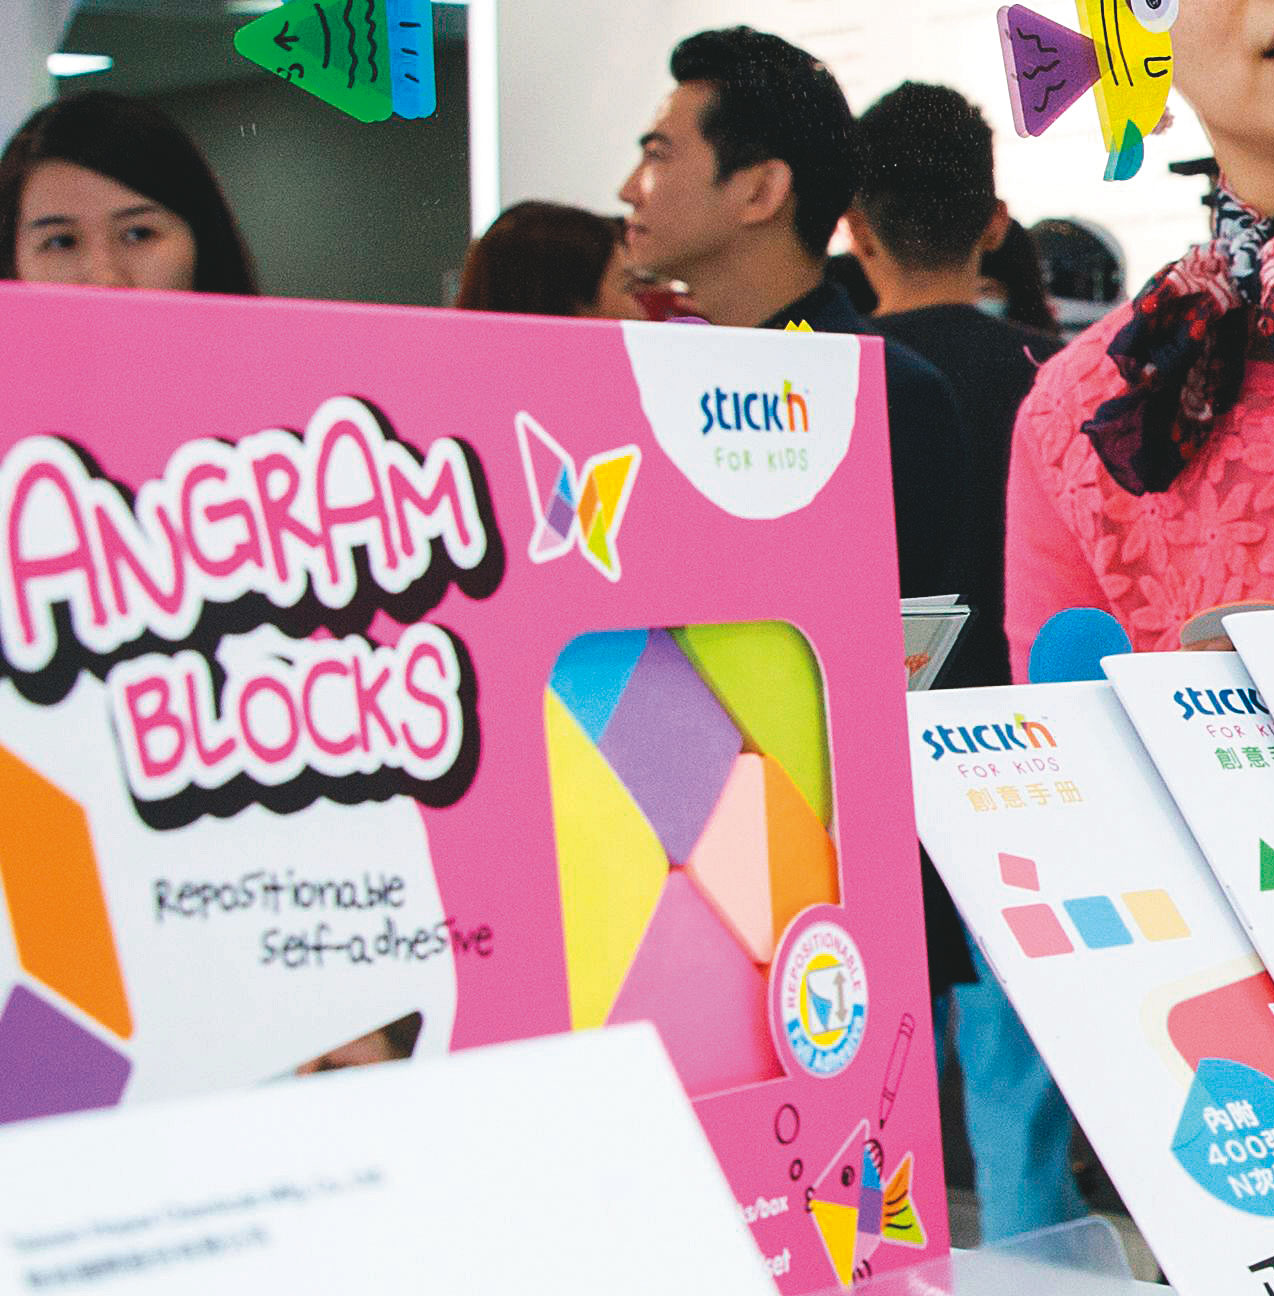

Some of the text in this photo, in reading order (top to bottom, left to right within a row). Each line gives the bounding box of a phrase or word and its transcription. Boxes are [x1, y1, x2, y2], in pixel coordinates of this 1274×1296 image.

[714, 446, 808, 471] FOR KIDS
[121, 640, 452, 782] BLOCKS
[1206, 724, 1246, 738] FOR
[957, 756, 1061, 779] FOR KIDS
[153, 870, 406, 923] Repositionable
